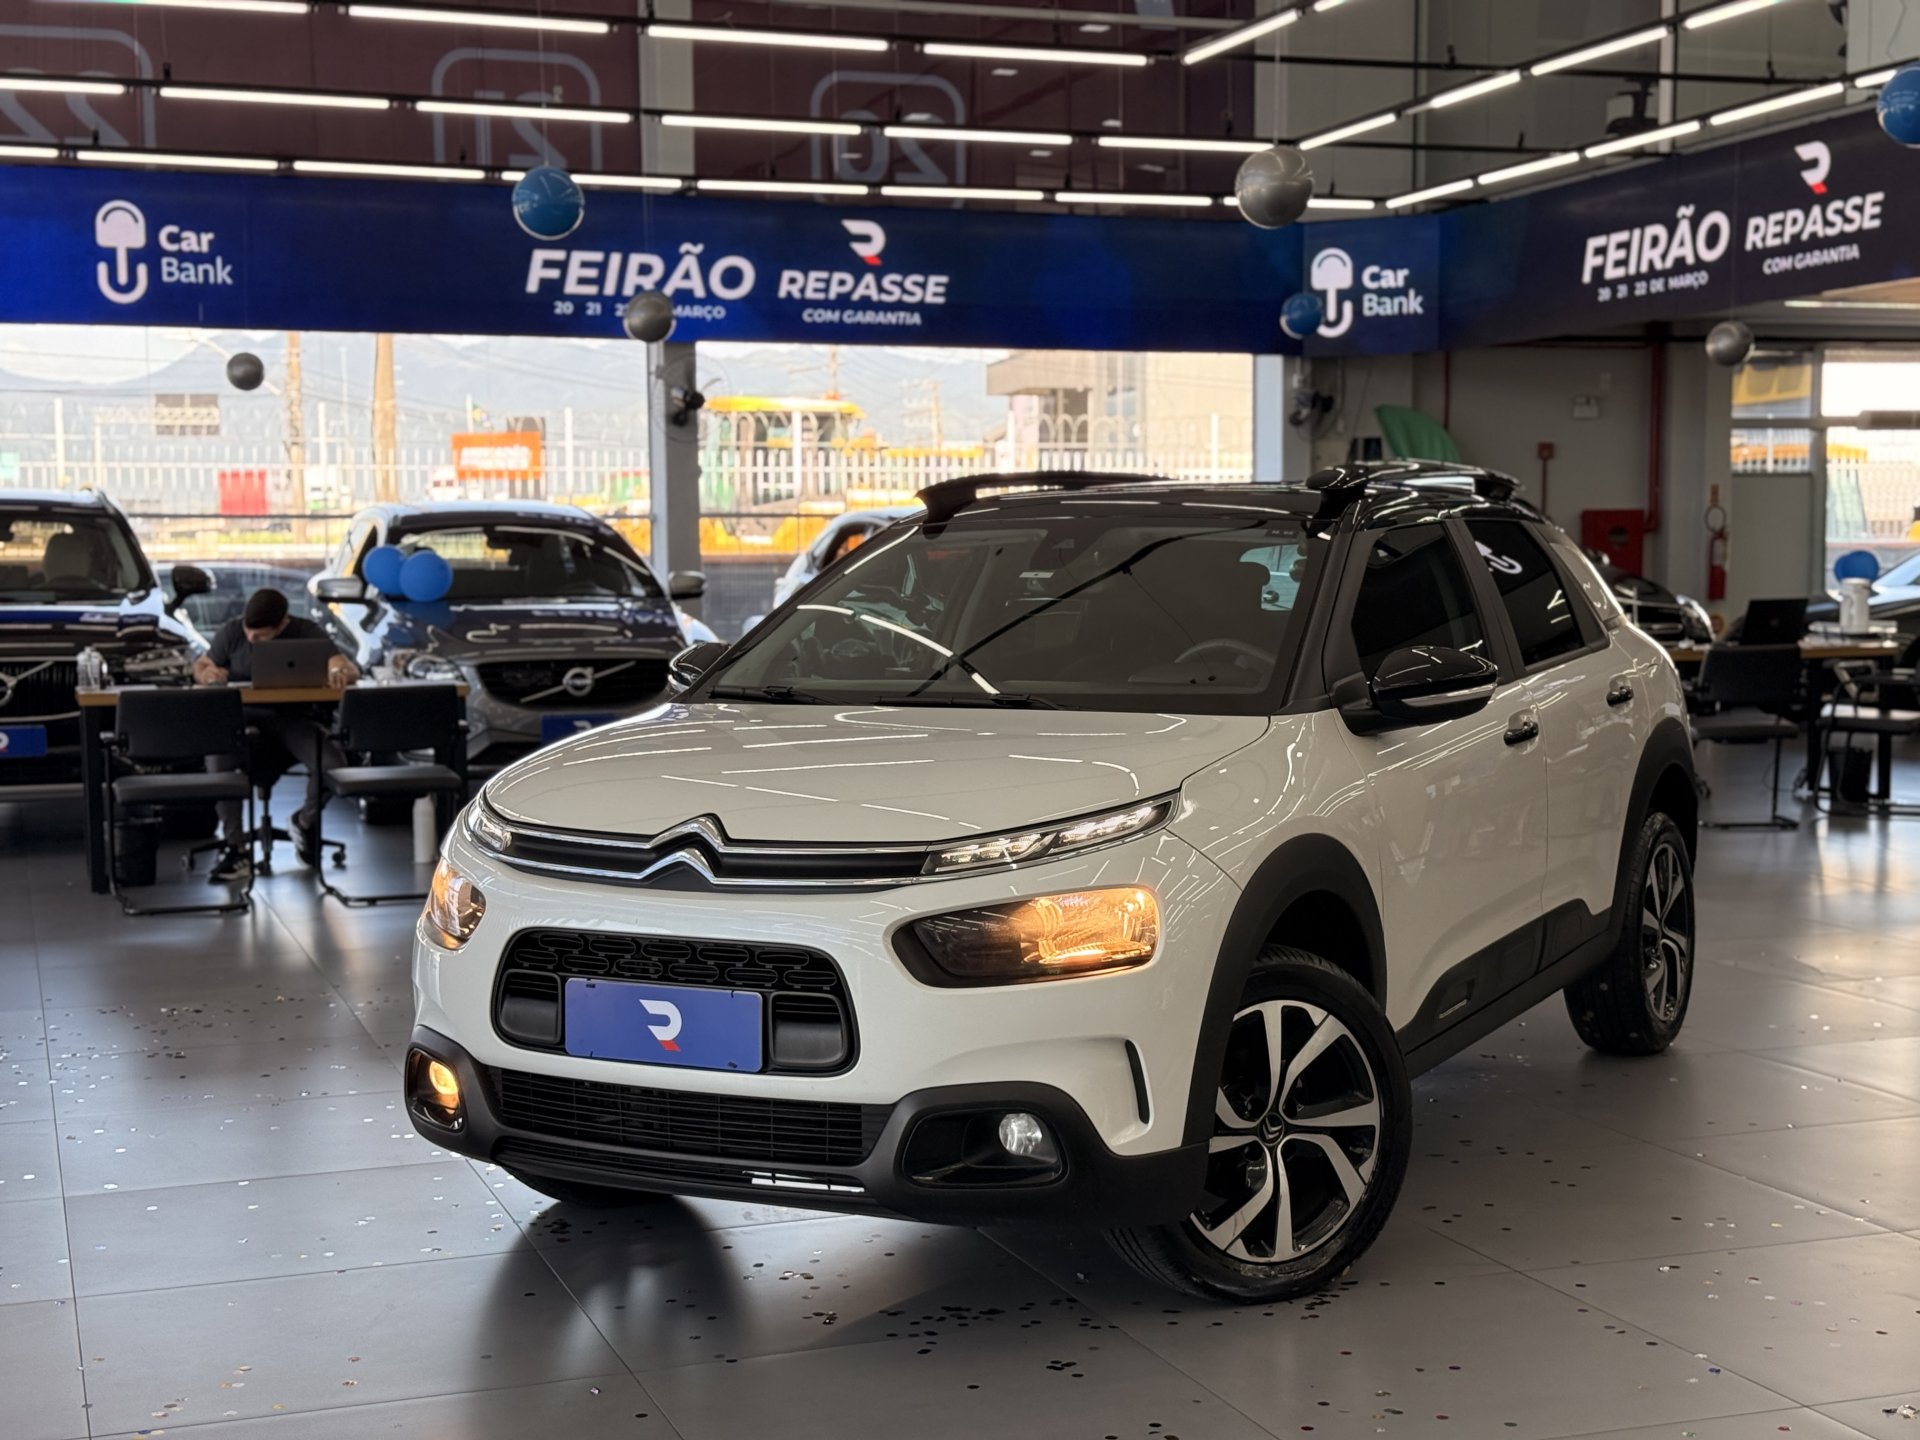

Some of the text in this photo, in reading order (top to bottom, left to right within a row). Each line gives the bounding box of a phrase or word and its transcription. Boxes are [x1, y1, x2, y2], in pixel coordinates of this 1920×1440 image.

[1745, 191, 1885, 251] REPASSE
[158, 224, 215, 252] Car
[1581, 203, 1731, 284] FEIRÃO
[160, 255, 233, 285] Bank
[525, 242, 756, 300] FEIRÃO
[1762, 243, 1860, 275] COM GARANTIA
[777, 269, 949, 304] REPASSE
[1361, 265, 1410, 289] Car
[1668, 269, 1709, 290] MARÇO
[553, 301, 574, 315] 20
[586, 302, 602, 316] 21
[615, 303, 629, 317] 2
[802, 308, 922, 325] COM GARANTIA
[1362, 288, 1424, 317] Bank
